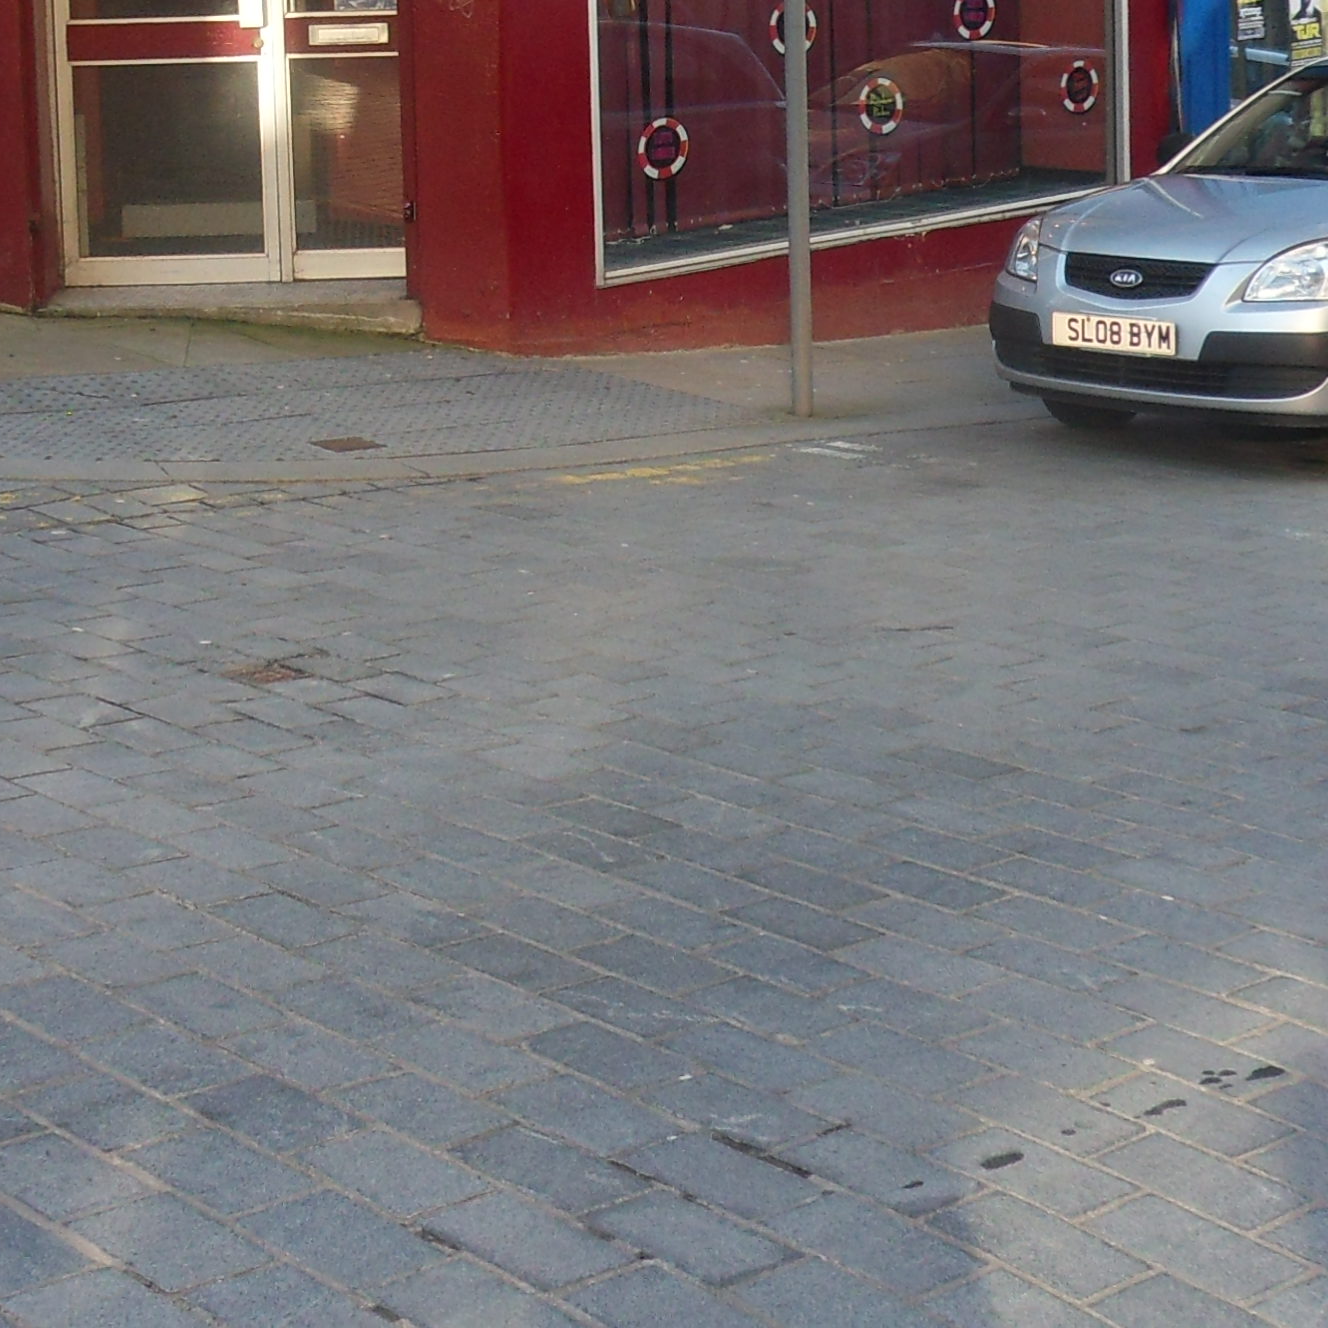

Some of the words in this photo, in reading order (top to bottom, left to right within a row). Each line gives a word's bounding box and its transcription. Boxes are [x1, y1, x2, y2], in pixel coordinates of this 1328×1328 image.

[1114, 273, 1137, 284] KIA
[1067, 317, 1122, 347] SL08
[1129, 322, 1171, 351] BYM
